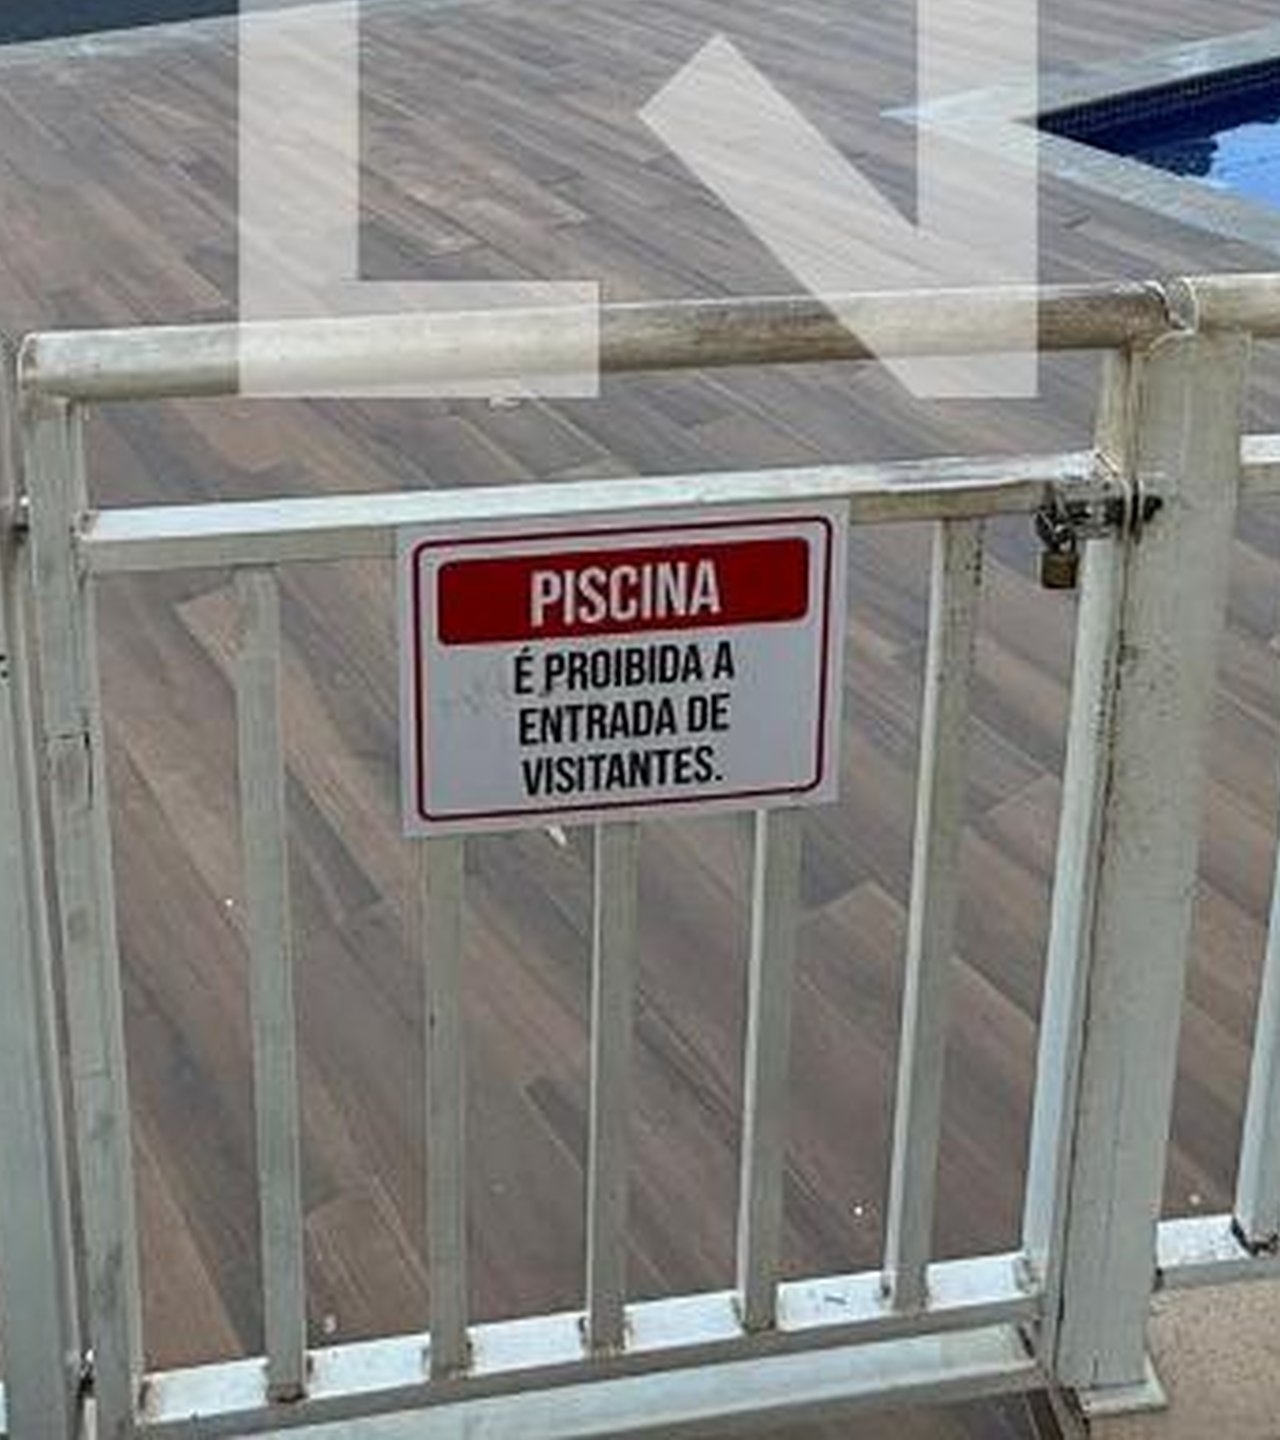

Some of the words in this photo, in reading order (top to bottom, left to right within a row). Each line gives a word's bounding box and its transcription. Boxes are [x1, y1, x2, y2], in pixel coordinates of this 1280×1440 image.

[530, 560, 721, 627] PISCINA
[514, 645, 535, 696] É
[544, 644, 703, 695] PROIBIDA
[712, 640, 736, 681] A
[520, 697, 677, 746] ENTRADA
[687, 693, 730, 734] DE
[522, 745, 723, 796] VISITANTES.
